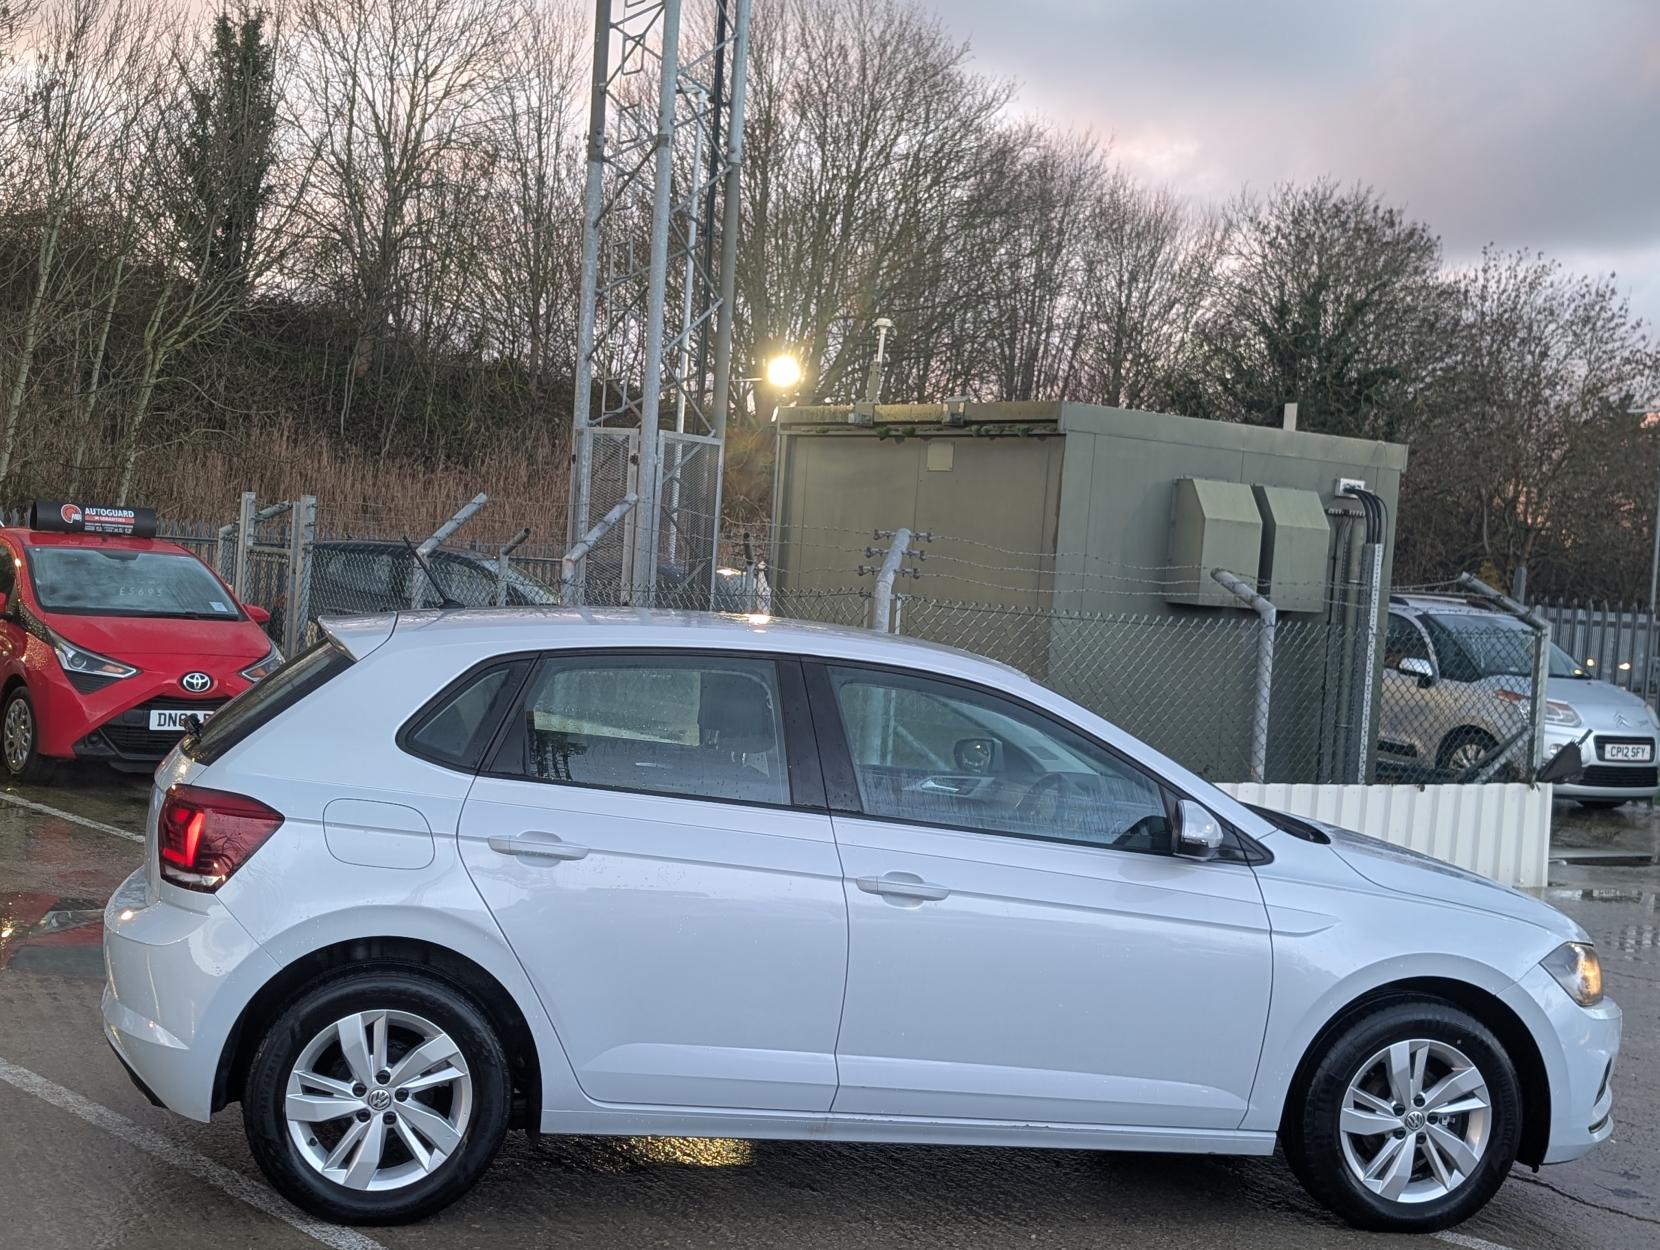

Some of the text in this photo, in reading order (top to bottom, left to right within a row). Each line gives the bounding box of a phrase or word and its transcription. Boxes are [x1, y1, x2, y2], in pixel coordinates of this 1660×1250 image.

[85, 507, 134, 518] AUTOGUARD
[1610, 746, 1646, 758] CP12 SFY
